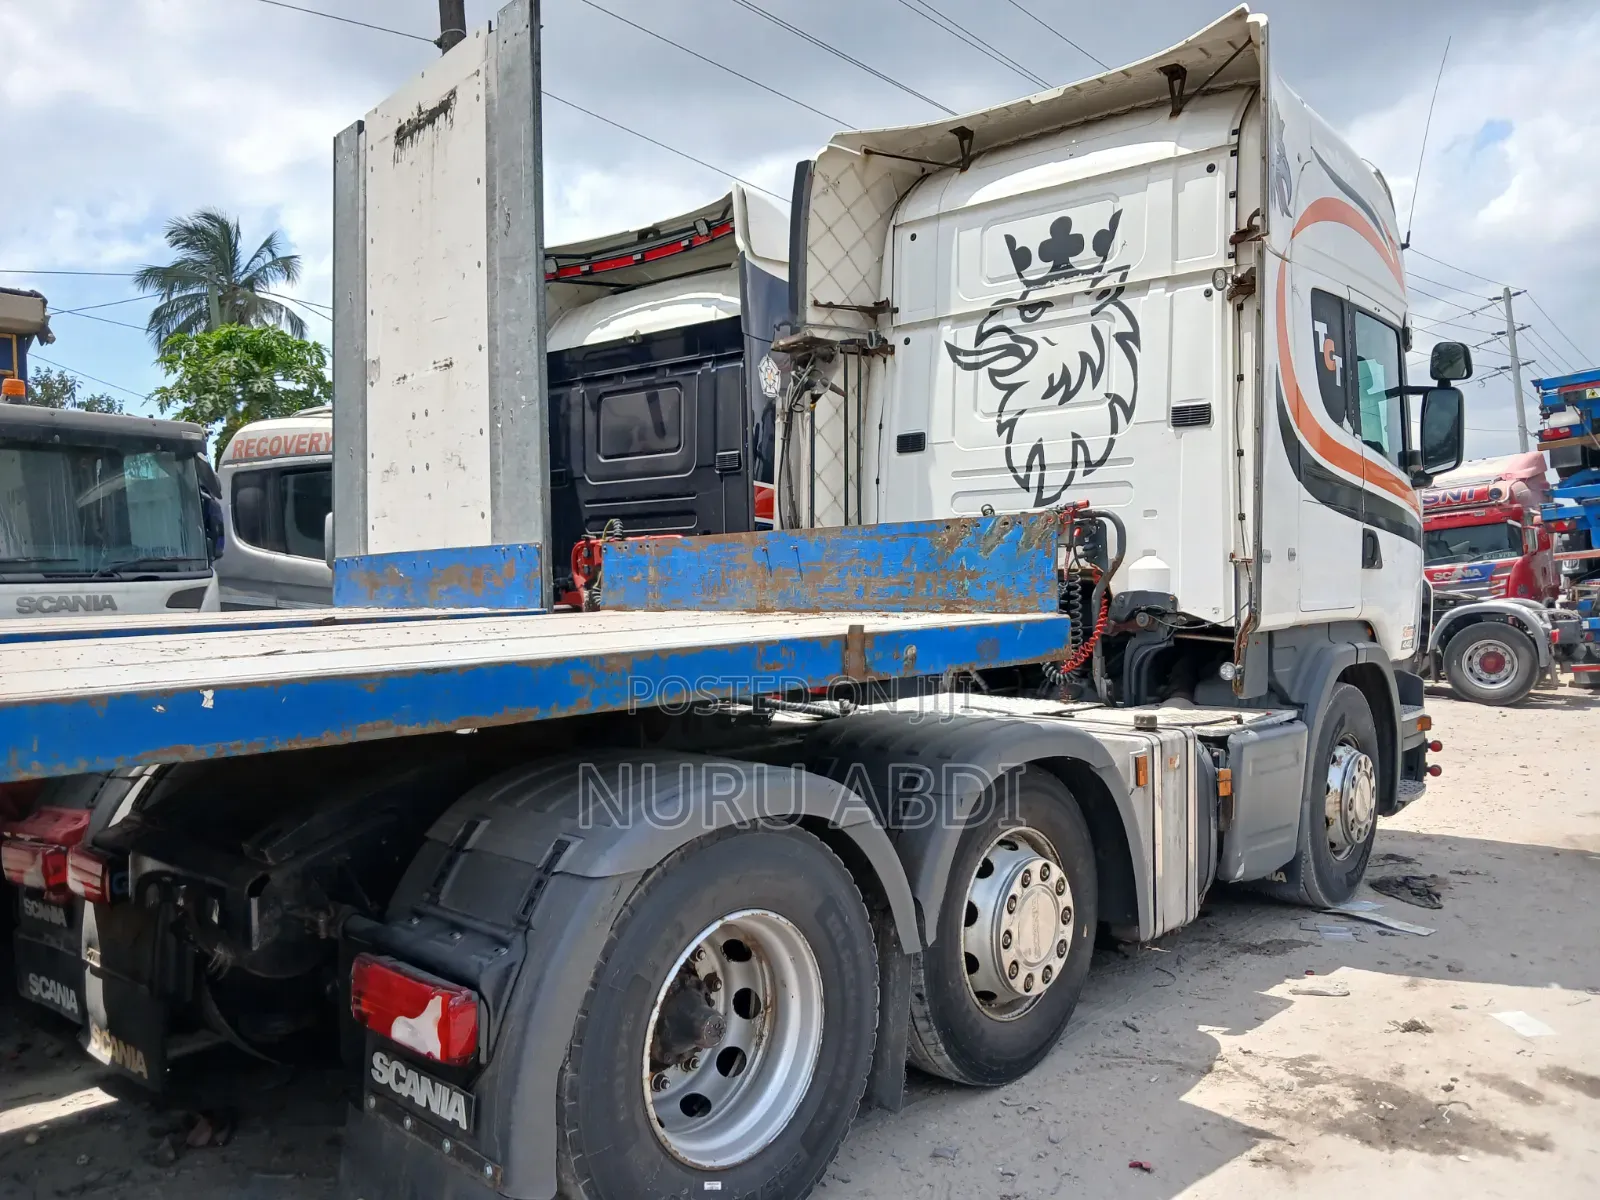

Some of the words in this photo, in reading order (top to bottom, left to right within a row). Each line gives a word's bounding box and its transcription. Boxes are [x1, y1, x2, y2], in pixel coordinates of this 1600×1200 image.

[232, 432, 332, 459] RECOVERY
[1433, 568, 1482, 580] SCANIA
[16, 594, 118, 614] SCANIA
[23, 898, 67, 928] SCANIA
[28, 973, 79, 1014] SCANIA
[90, 1023, 148, 1080] SCANIA
[370, 1051, 468, 1131] SCANIA
